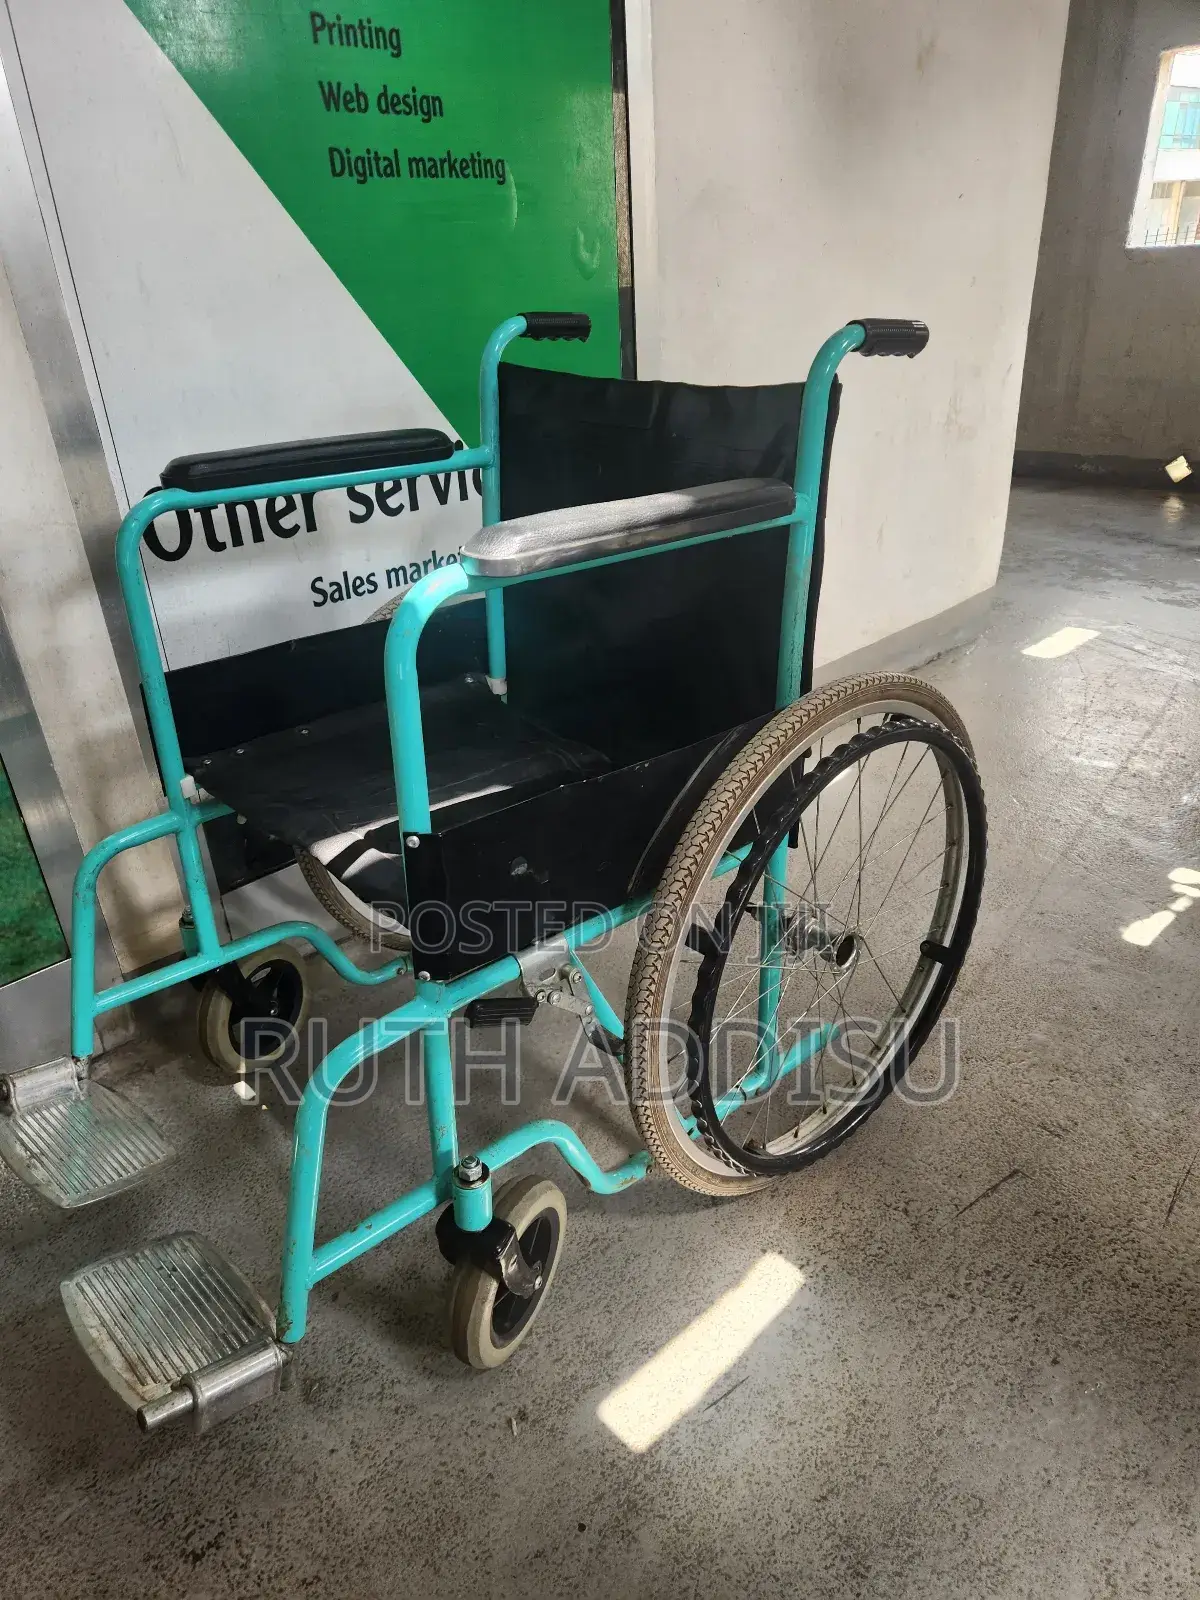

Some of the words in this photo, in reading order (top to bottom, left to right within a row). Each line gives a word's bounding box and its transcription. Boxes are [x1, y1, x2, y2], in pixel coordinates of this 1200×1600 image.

[309, 11, 402, 58] Printing
[318, 80, 369, 114] Web
[376, 85, 444, 124] design
[328, 146, 401, 184] Digital
[408, 150, 506, 185] marketing
[310, 567, 378, 607] Sales
